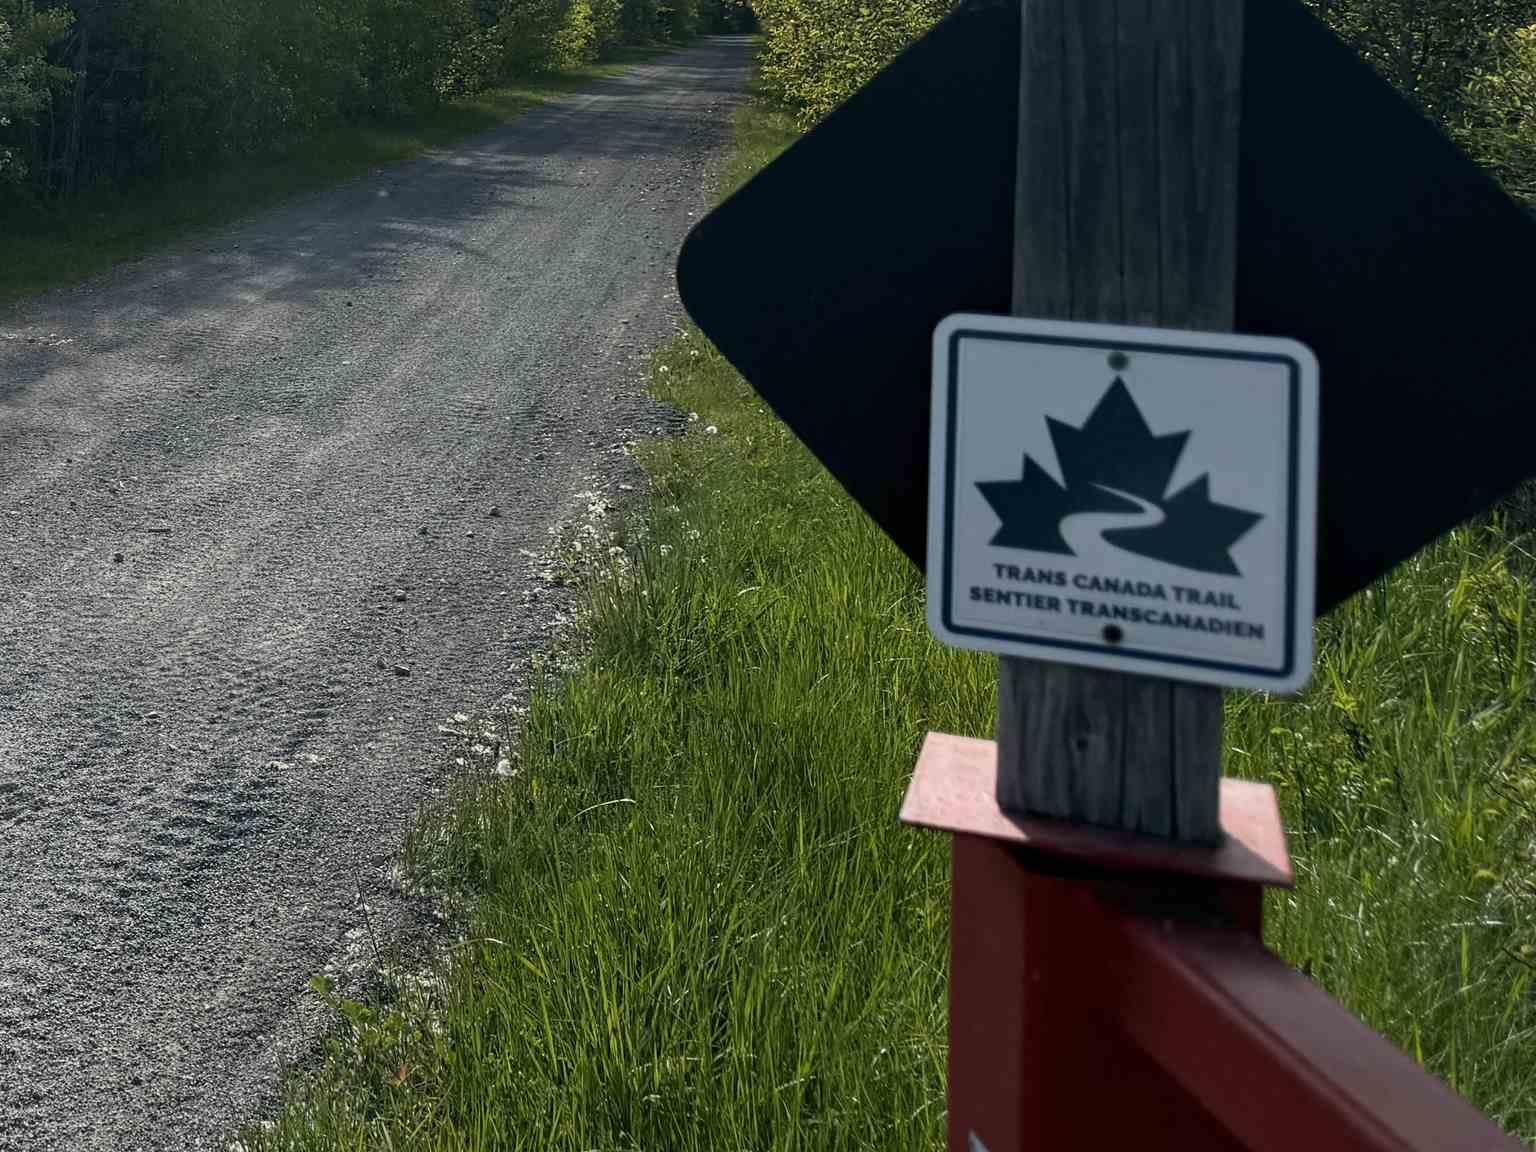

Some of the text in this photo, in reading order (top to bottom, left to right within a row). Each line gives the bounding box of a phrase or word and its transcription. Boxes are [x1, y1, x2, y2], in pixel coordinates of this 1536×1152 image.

[994, 563, 1240, 610] TRANS CANADA TRAIL
[970, 586, 1265, 640] SENTIER TRANSCANADIEN
